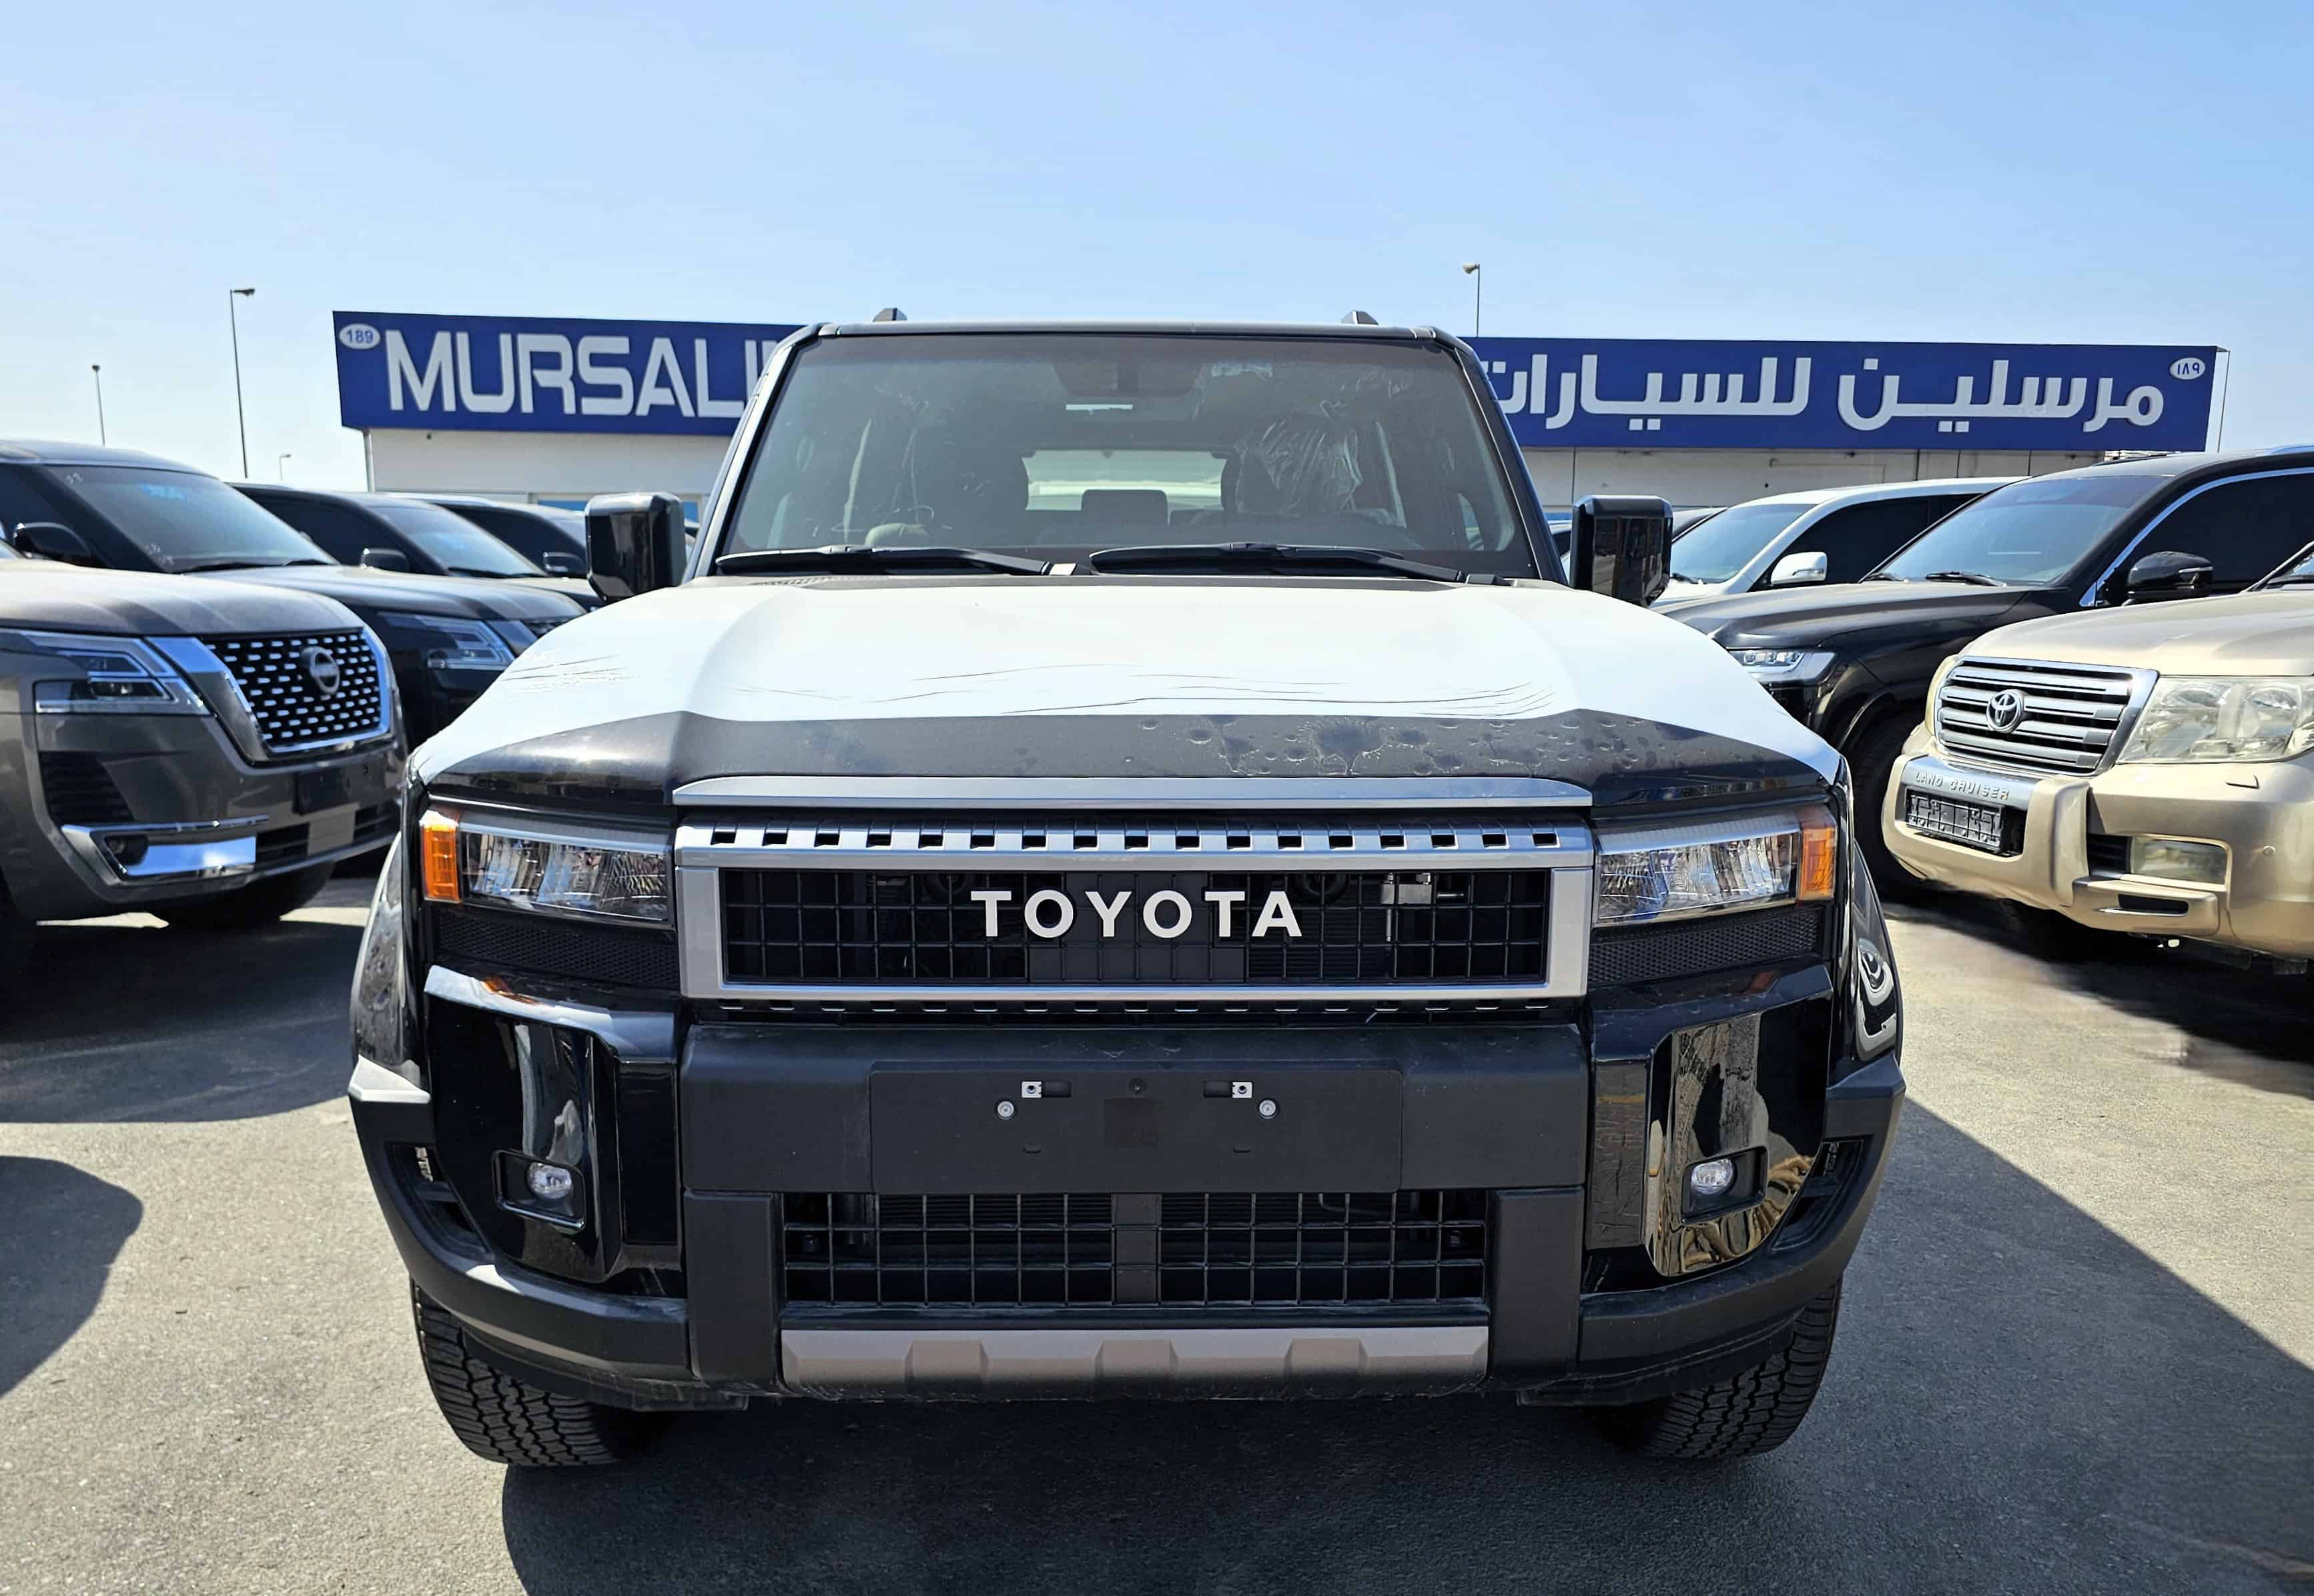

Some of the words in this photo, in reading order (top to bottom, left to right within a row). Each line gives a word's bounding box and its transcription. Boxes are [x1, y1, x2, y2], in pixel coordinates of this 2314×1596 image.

[346, 329, 374, 344] 189
[2177, 362, 2201, 376] ١٨٩
[1837, 358, 2165, 432] مرسلين
[1916, 771, 1944, 787] LAND
[1948, 779, 2010, 801] CRUISER
[970, 889, 1303, 938] TOYOTA
